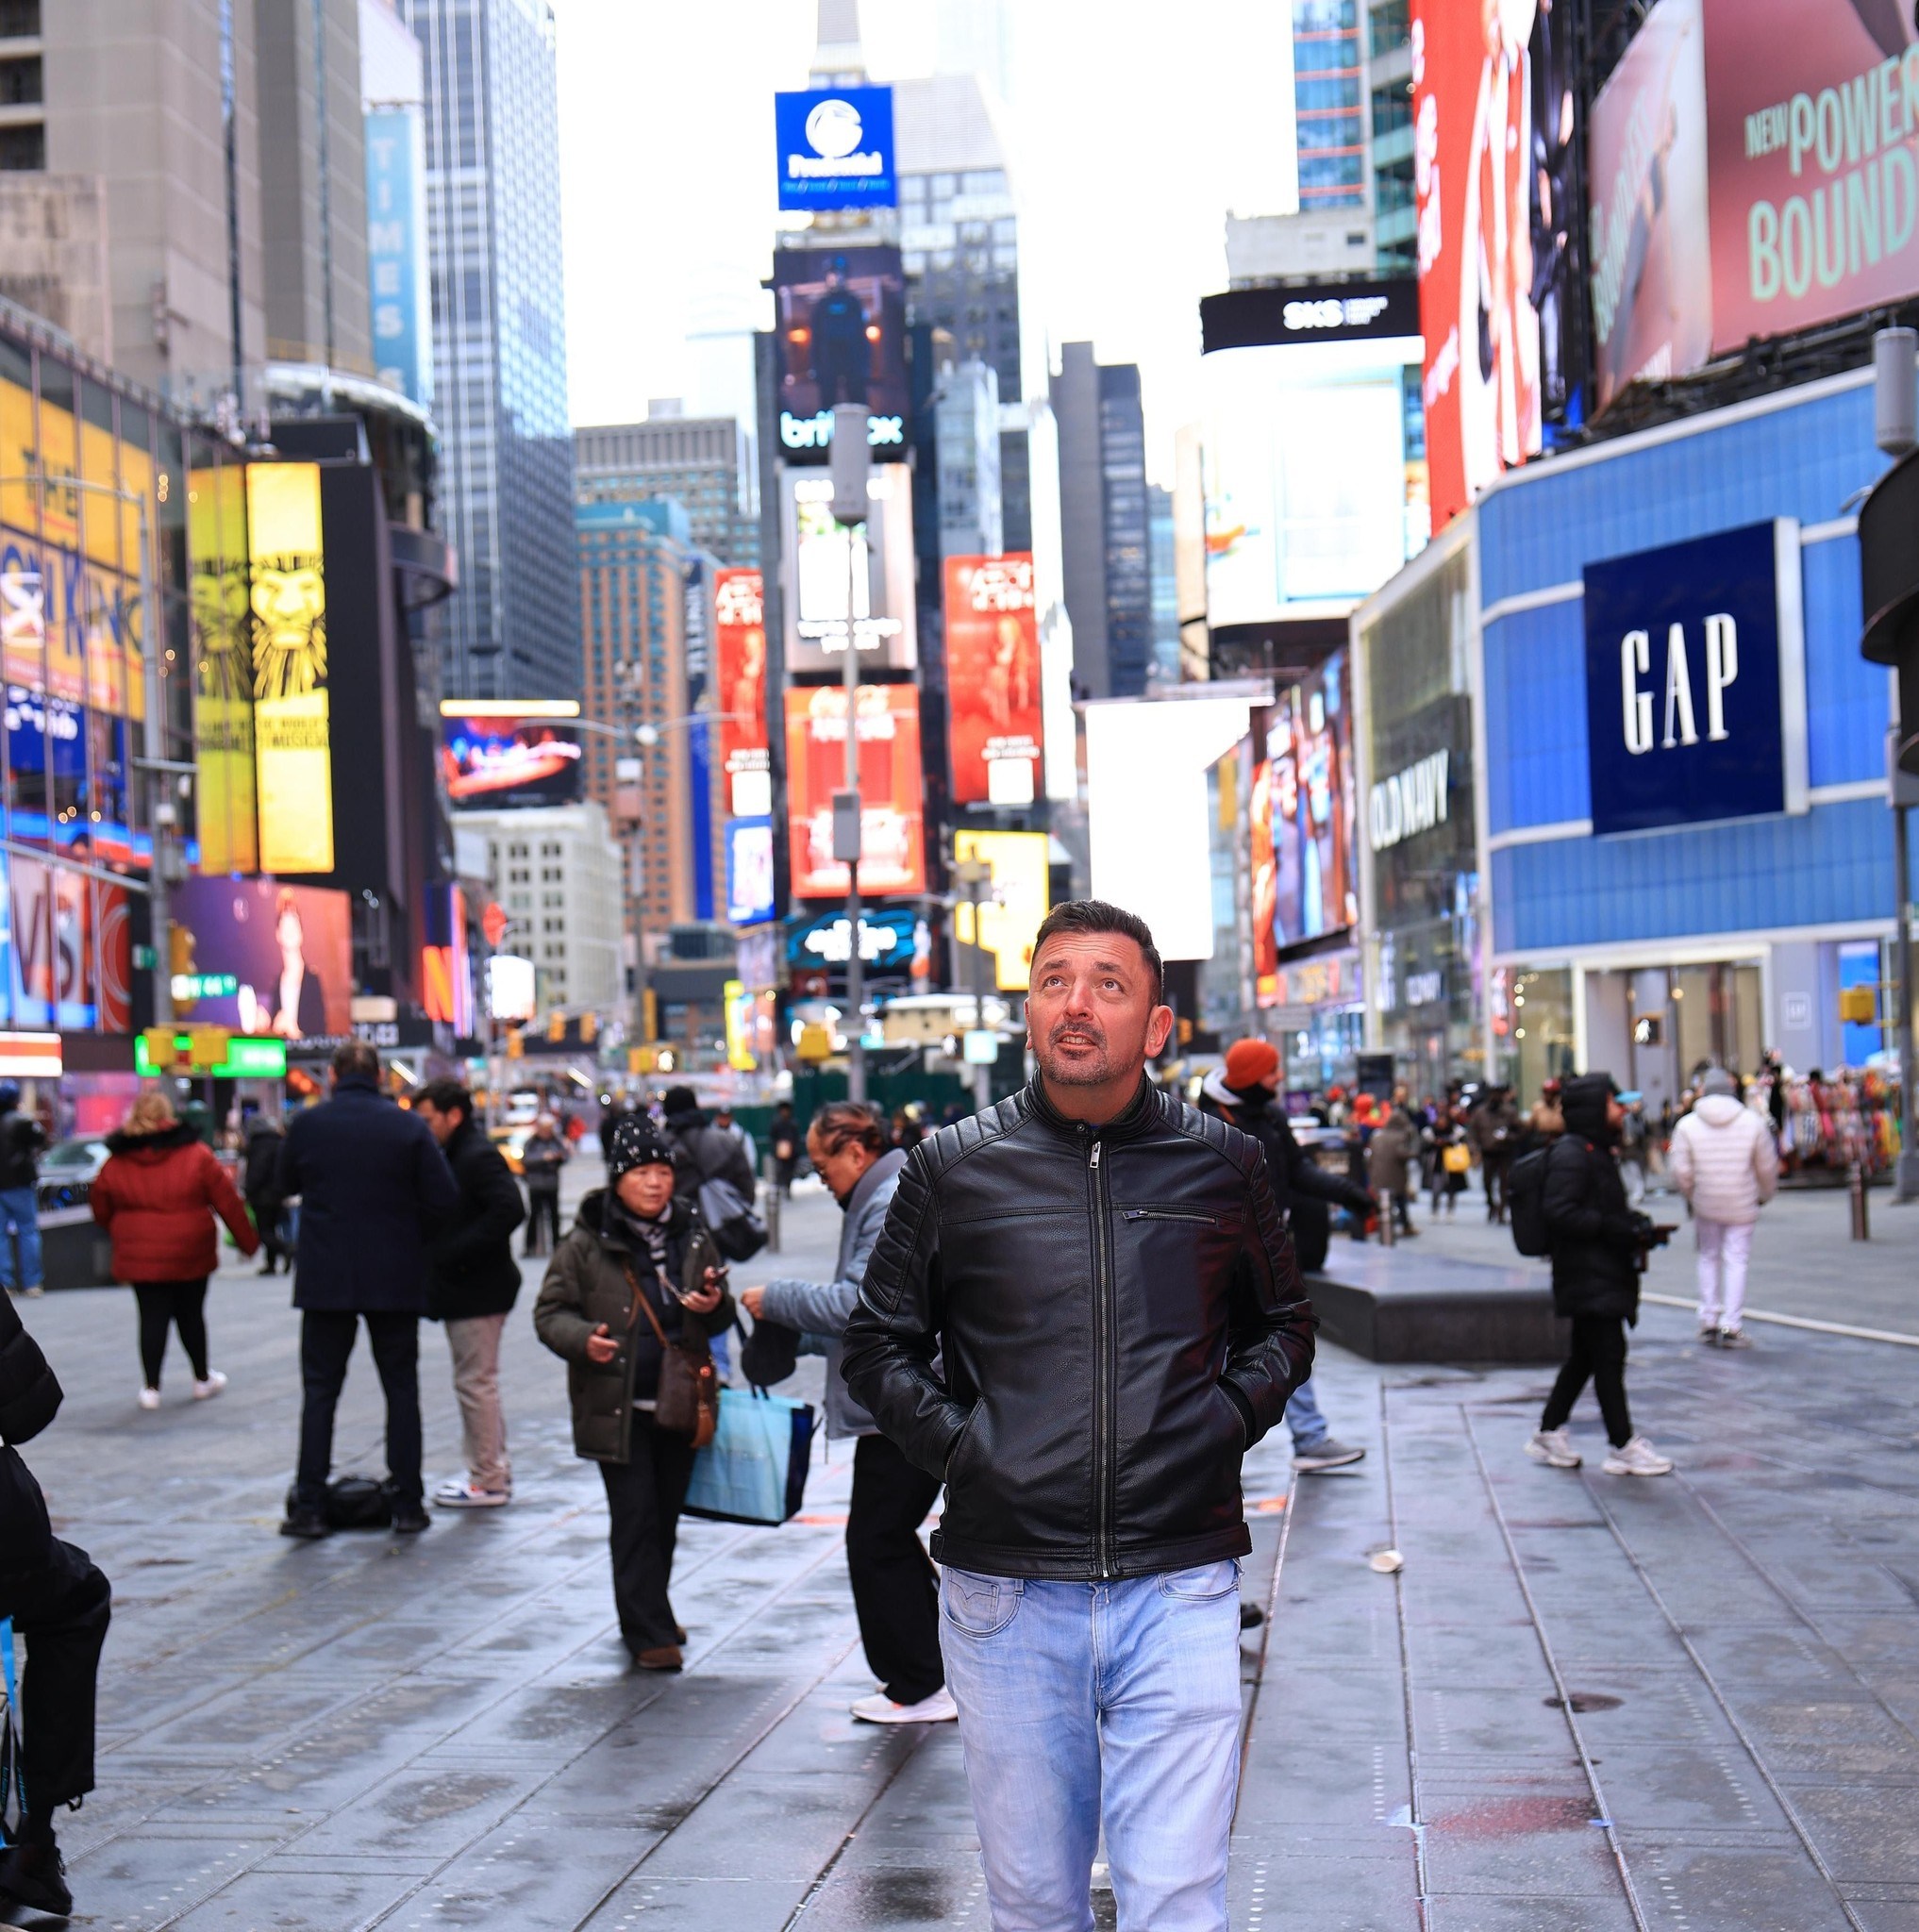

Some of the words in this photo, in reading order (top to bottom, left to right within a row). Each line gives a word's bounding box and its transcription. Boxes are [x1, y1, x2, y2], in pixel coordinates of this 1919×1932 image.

[1745, 101, 1788, 160] NEW
[368, 138, 405, 339] TIMES
[1749, 145, 1918, 302] BOUND
[1283, 299, 1343, 330] SKS
[1621, 613, 1738, 756] GAP
[1369, 774, 1402, 852] OLD
[1400, 747, 1449, 839] NAVY
